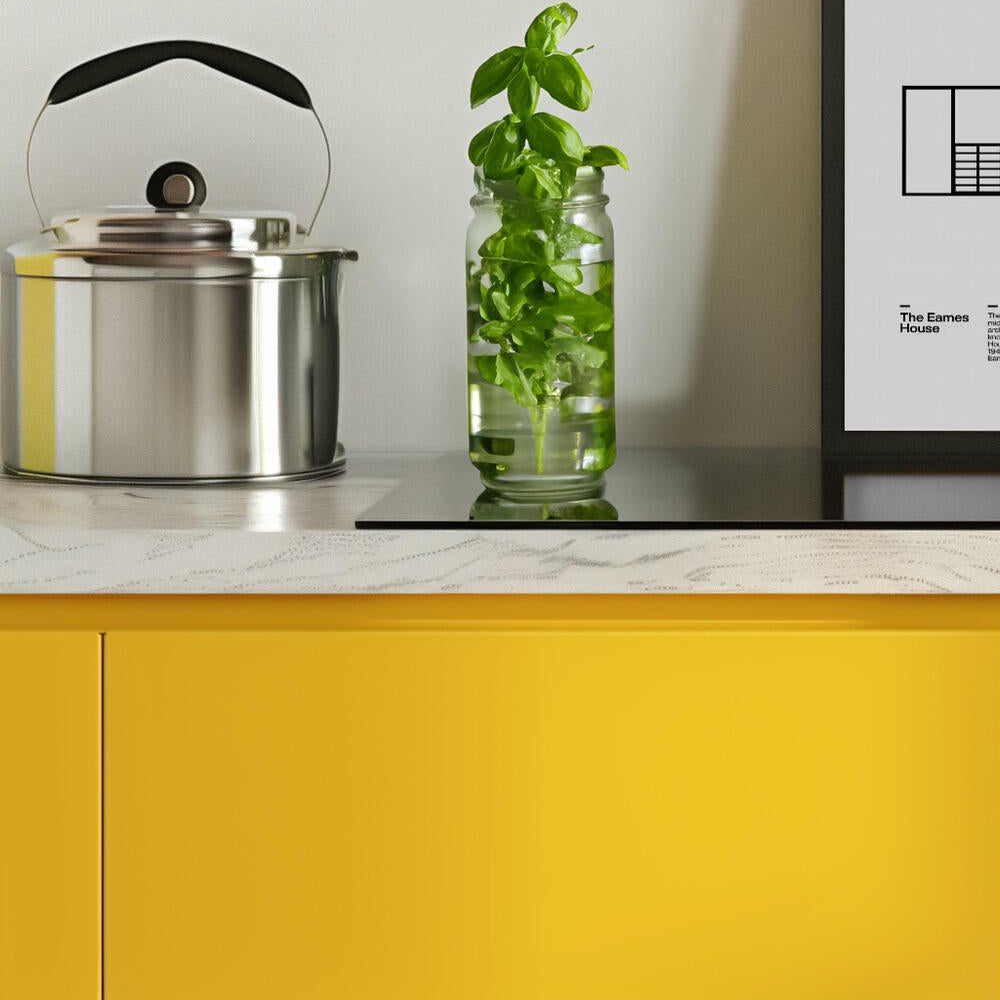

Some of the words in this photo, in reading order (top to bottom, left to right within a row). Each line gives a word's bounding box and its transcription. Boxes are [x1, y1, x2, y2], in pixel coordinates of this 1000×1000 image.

[900, 311, 925, 322] The
[927, 311, 970, 322] Eames
[900, 322, 940, 333] House
